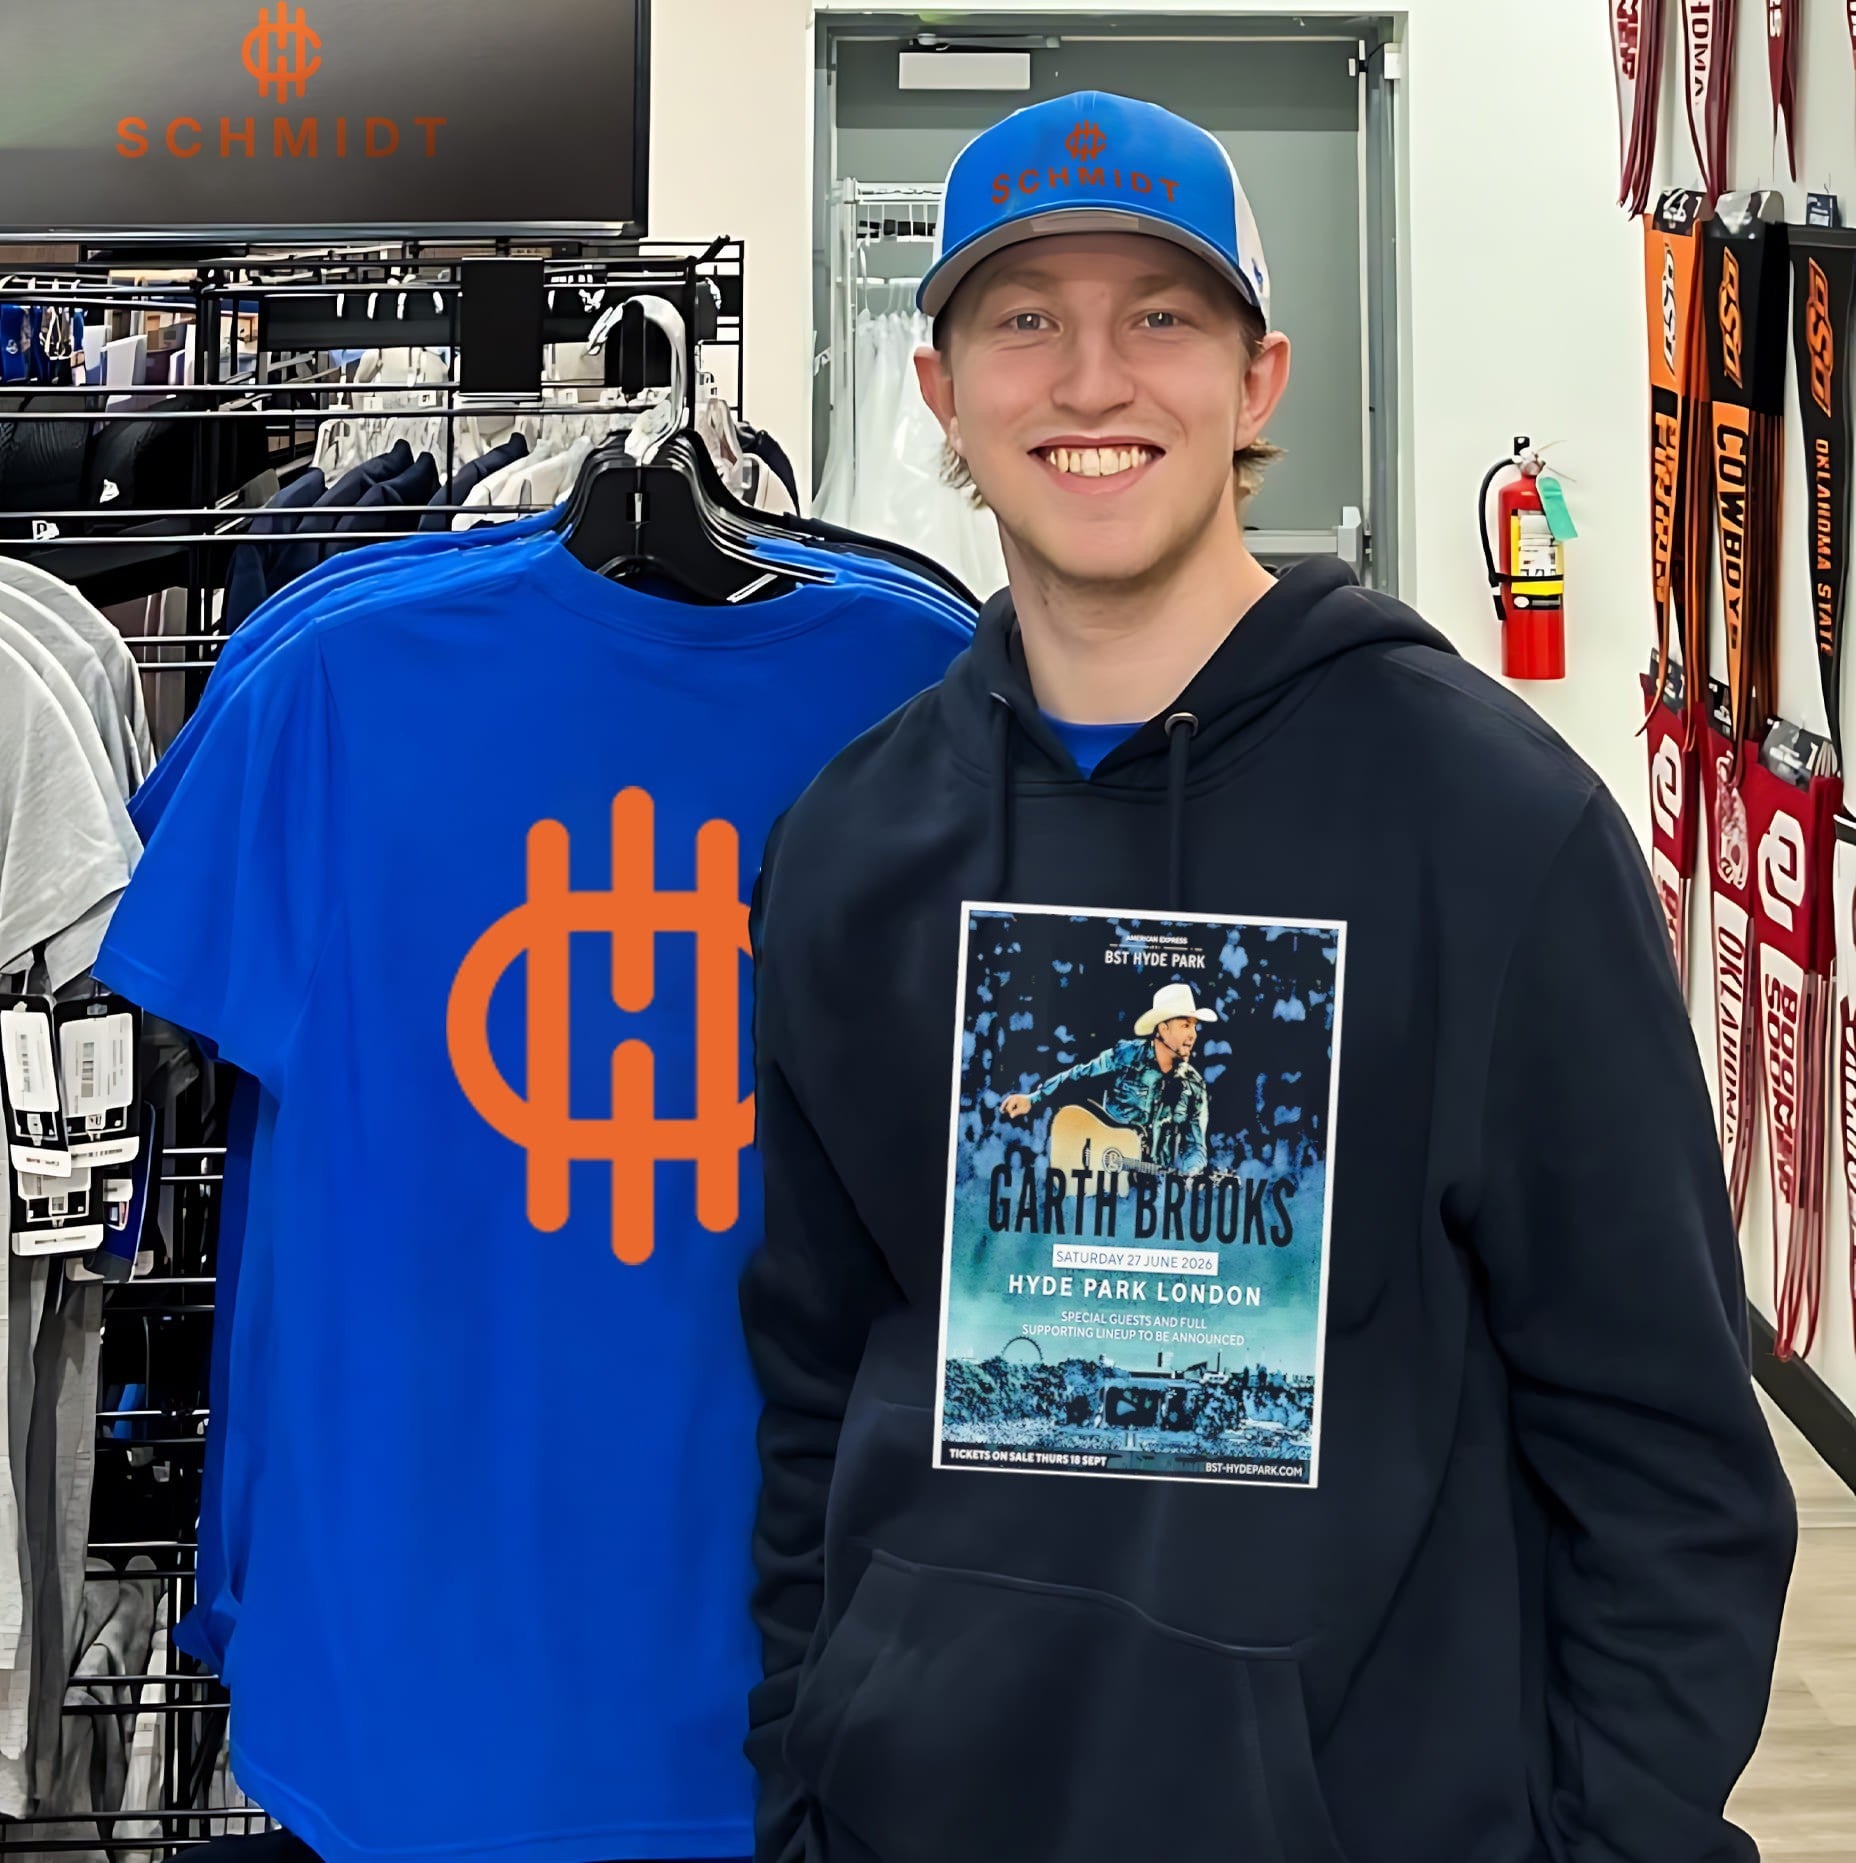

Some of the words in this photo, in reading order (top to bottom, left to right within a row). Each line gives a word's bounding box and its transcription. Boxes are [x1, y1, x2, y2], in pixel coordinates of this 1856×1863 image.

[116, 116, 448, 159] SCHMIDT
[991, 167, 1179, 204] SCHMIDT
[1126, 934, 1158, 943] AMERICAN
[1159, 935, 1188, 944] EXPRESS
[1105, 950, 1129, 964] BST
[1133, 952, 1168, 966] HYDE
[1171, 953, 1206, 969] PARK
[988, 1163, 1119, 1236] GARTH
[1134, 1171, 1295, 1248] BROOKS
[1056, 1250, 1124, 1266] SATURDAY
[1127, 1254, 1141, 1266] 27
[1143, 1255, 1178, 1268] JUNE
[1181, 1257, 1213, 1270] 2026
[1008, 1274, 1073, 1297] HYDE
[1084, 1278, 1147, 1301] PARK
[1157, 1281, 1261, 1306] LONDON
[1061, 1311, 1107, 1325] SPECIAL
[1109, 1313, 1151, 1326] GUESTS
[1153, 1316, 1178, 1328] AND
[1180, 1317, 1207, 1329] FULL
[1022, 1323, 1094, 1338] SUPPORTING
[1096, 1326, 1135, 1340] LINEUP
[1138, 1330, 1153, 1341] TO
[1156, 1331, 1170, 1342] BE
[1171, 1332, 1245, 1346] ANNOUNCED
[949, 1448, 991, 1461] TICKETS
[992, 1450, 1008, 1461] ON
[1009, 1452, 1034, 1463] SALE
[1035, 1453, 1069, 1465] THURS
[1070, 1454, 1081, 1465] 18
[1082, 1455, 1107, 1466] SEPT
[1205, 1462, 1303, 1477] BST-HYDEPARK.COM
